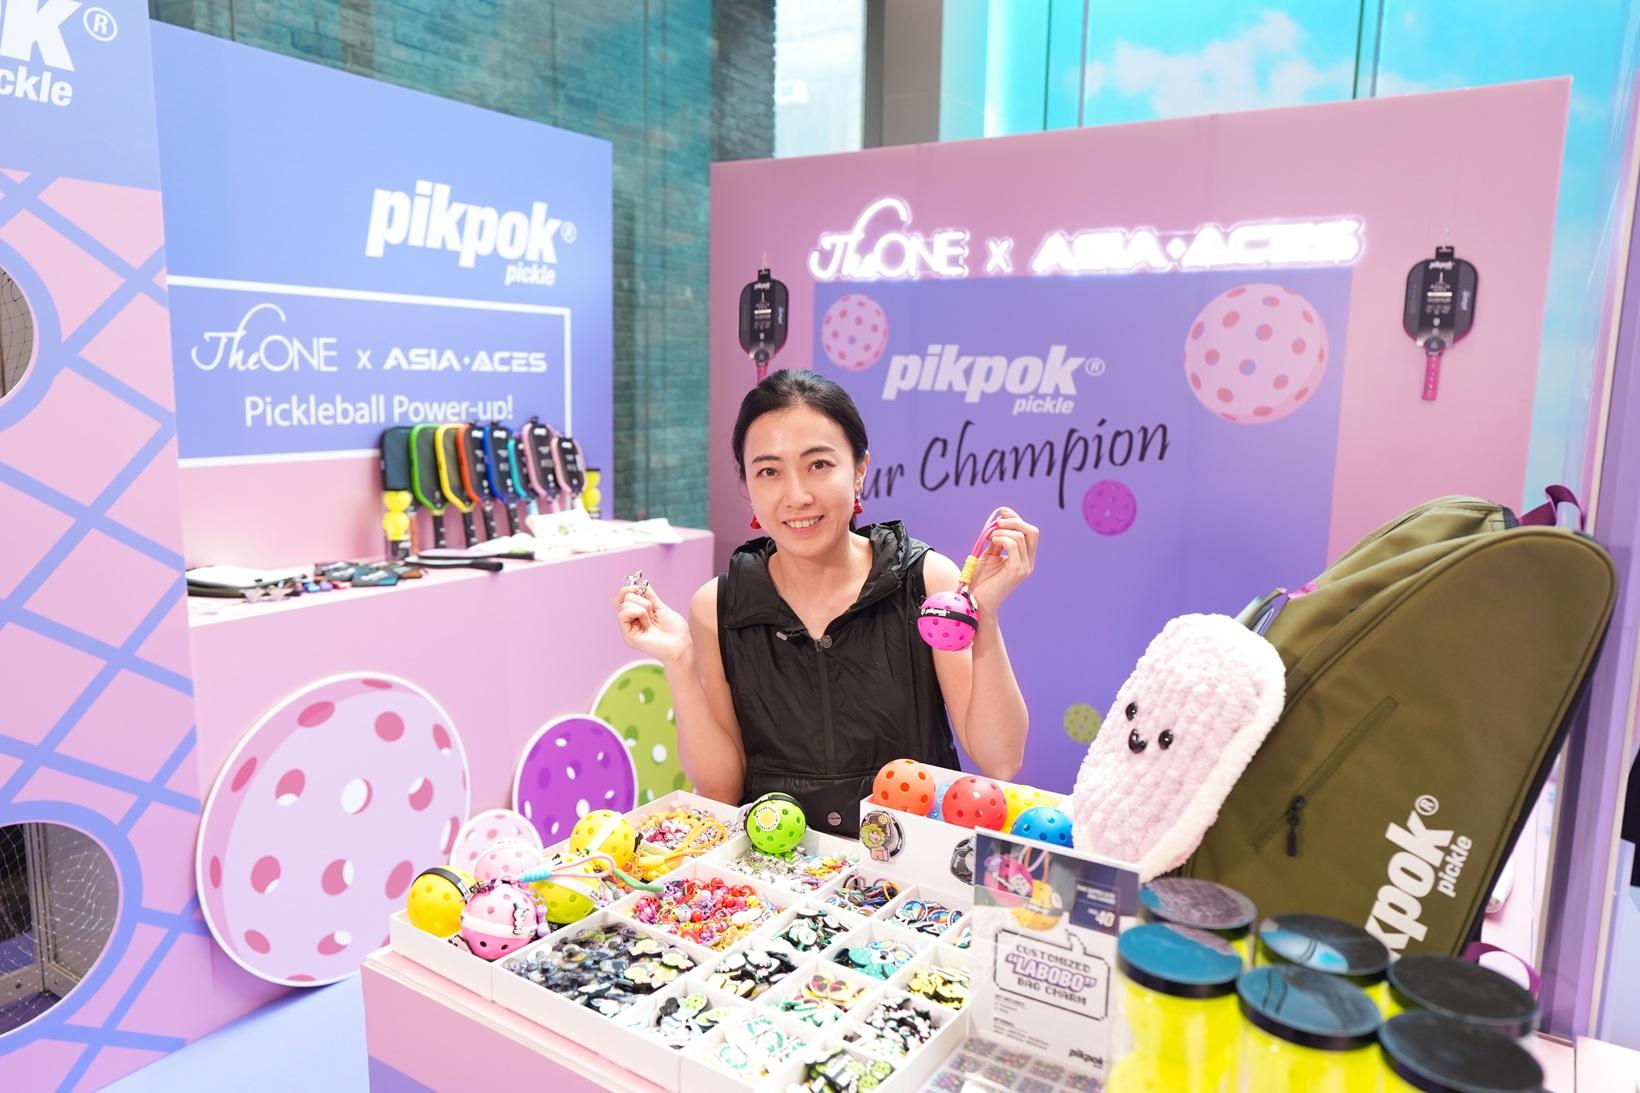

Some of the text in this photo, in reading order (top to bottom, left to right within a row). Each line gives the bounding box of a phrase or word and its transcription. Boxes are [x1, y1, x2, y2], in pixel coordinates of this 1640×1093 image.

[504, 261, 557, 286] pickle
[245, 394, 514, 427] Pickleball Power-up!
[1012, 396, 1075, 415] pickle
[920, 418, 1170, 510] Champion
[1437, 835, 1473, 898] pickle
[1015, 944, 1092, 974] CUSTOMIZED
[1017, 977, 1041, 992] BAG
[1045, 985, 1088, 1006] CHARM
